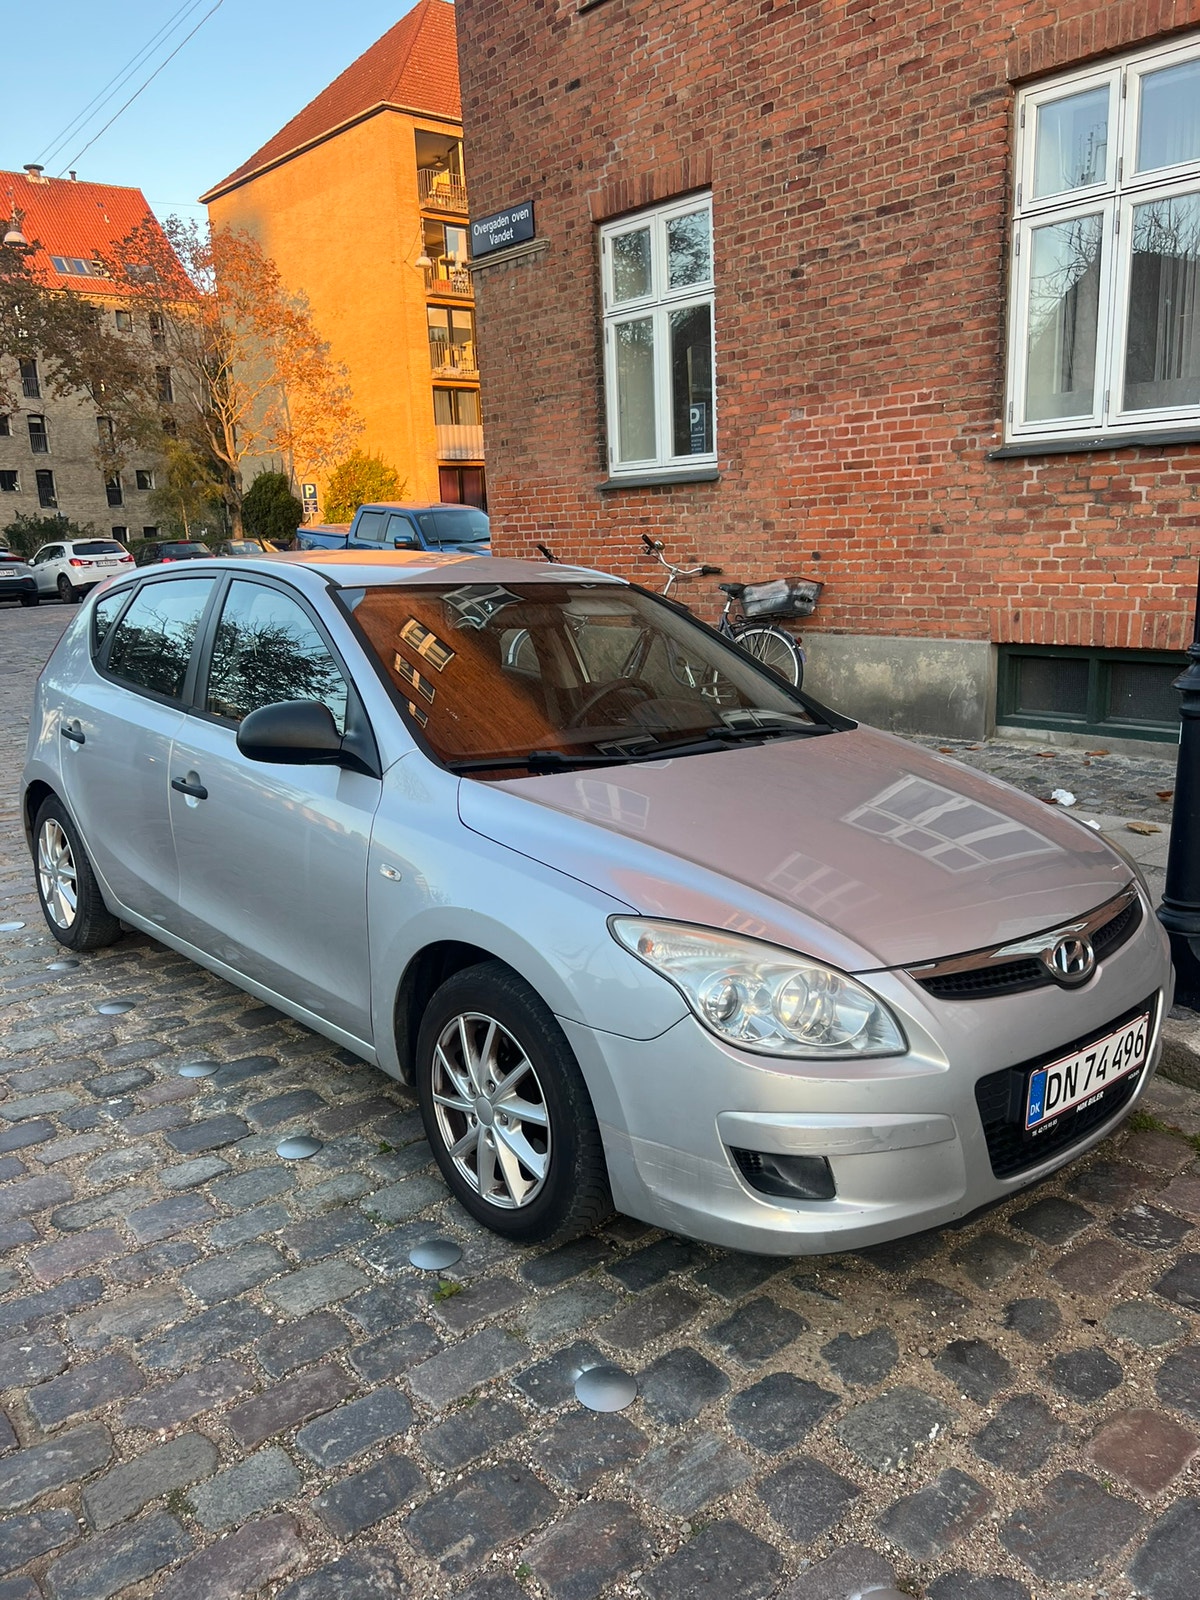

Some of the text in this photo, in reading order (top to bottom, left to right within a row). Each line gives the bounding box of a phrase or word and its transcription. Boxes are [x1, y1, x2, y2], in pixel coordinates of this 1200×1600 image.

[473, 208, 529, 236] Overgaden oven
[489, 227, 514, 245] Vandet
[690, 408, 700, 432] P
[305, 485, 315, 498] P
[1045, 1023, 1144, 1111] DN 74 496
[1030, 1101, 1041, 1116] DK
